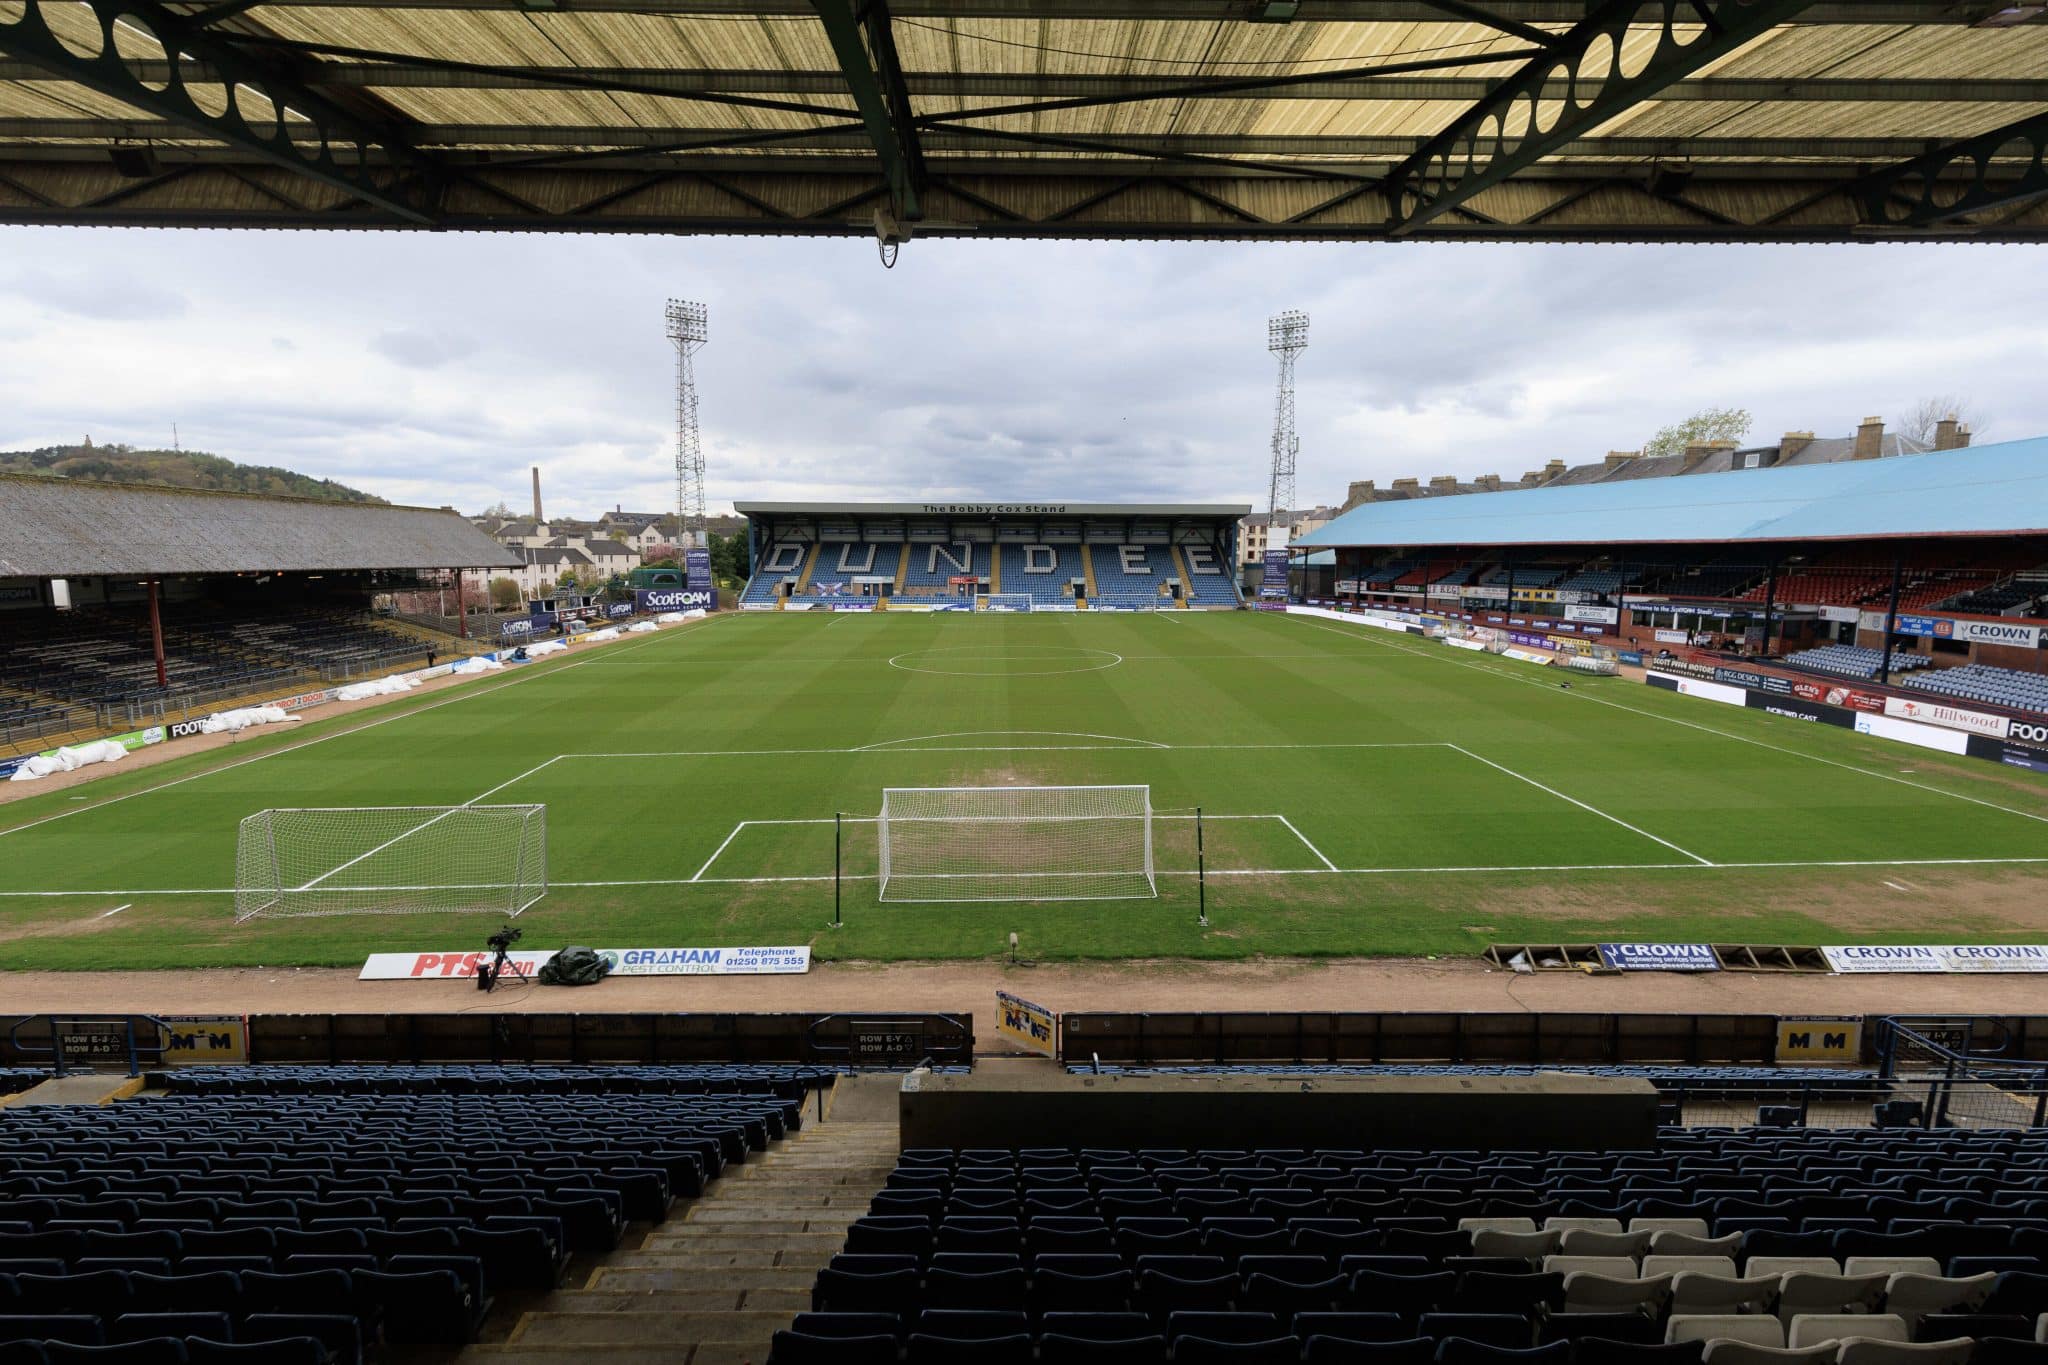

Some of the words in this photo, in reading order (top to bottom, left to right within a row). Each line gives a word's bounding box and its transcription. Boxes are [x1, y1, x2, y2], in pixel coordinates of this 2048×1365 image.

[923, 505, 946, 513] The
[950, 505, 992, 514] Bobby
[997, 505, 1021, 513] Cox
[1025, 505, 1066, 513] Stand
[764, 541, 1221, 574] DUNDEE
[1969, 624, 2031, 640] CROWN
[1933, 707, 2001, 730] Hillwood
[2008, 722, 2048, 743] FOO
[737, 948, 796, 957] Telephone
[1619, 944, 1710, 957] CROWN
[1844, 947, 1933, 958] CROWN
[1953, 946, 2042, 958] CROWN
[623, 950, 721, 965] GRAHAM
[726, 958, 758, 966] 01250
[783, 957, 804, 965] 555
[410, 952, 487, 977] PTS
[622, 965, 655, 973] PEST
[657, 965, 716, 973] CONTROL
[64, 1035, 88, 1044] ROW
[859, 1035, 882, 1043] ROW
[886, 1035, 902, 1043] E-Y
[65, 1045, 89, 1053] ROW
[92, 1045, 110, 1053] A-D
[859, 1044, 883, 1052] ROW
[886, 1044, 903, 1052] A-D
